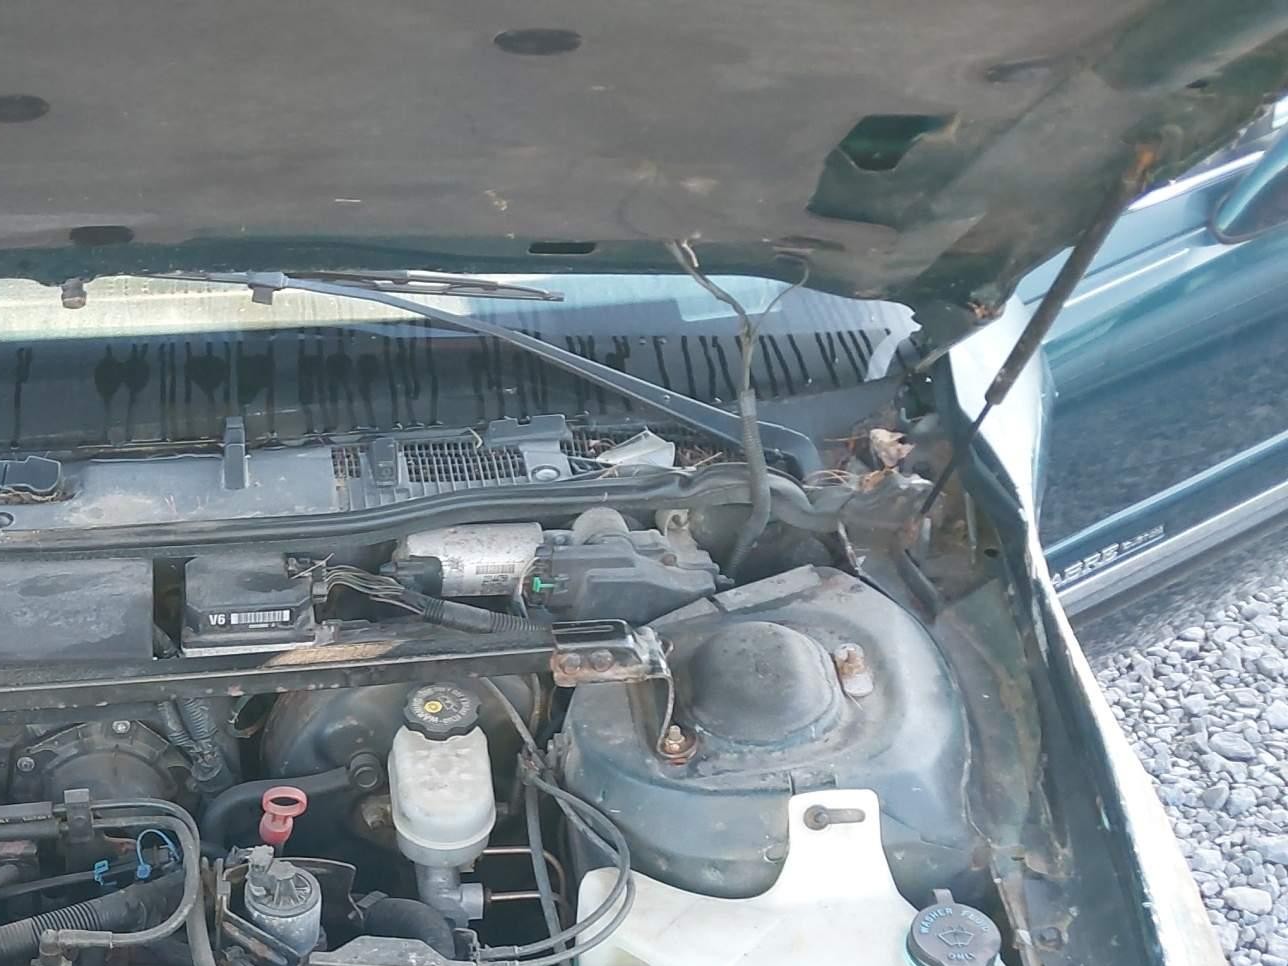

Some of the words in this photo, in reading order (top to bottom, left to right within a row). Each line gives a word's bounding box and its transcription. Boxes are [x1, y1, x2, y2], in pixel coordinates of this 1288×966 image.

[209, 614, 226, 625] V6
[920, 908, 953, 933] WASHER
[947, 952, 976, 961] ONLY
